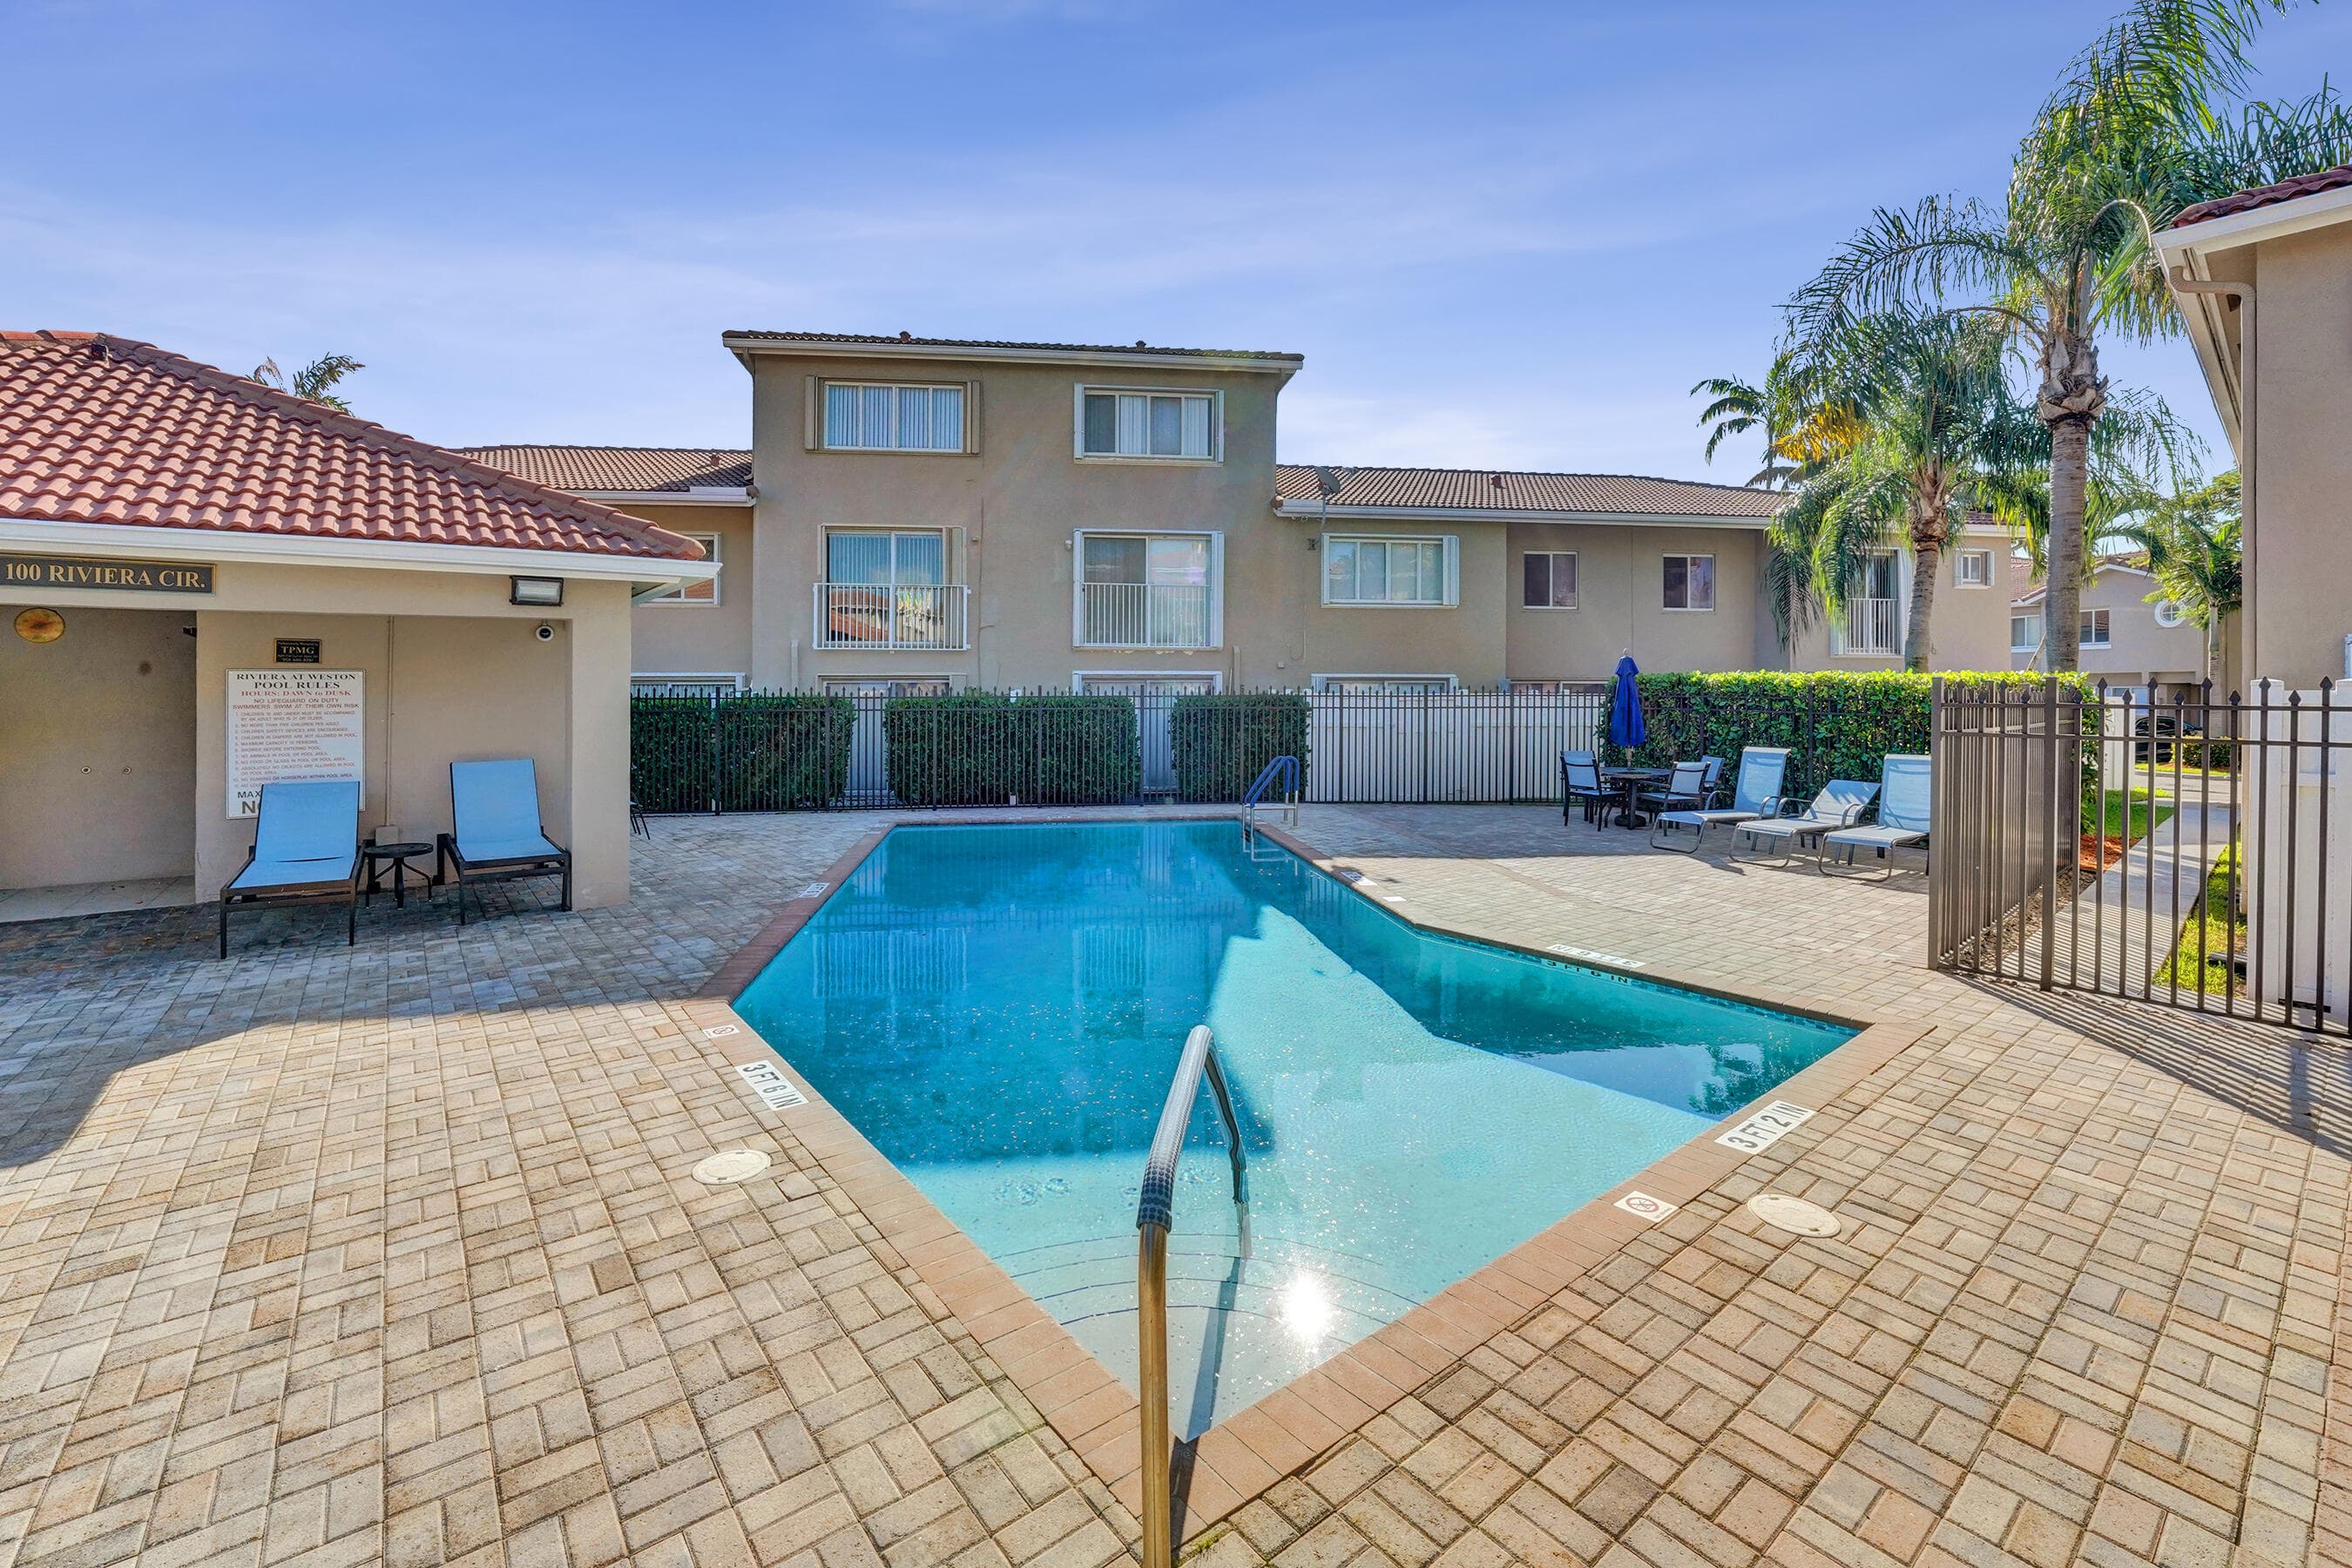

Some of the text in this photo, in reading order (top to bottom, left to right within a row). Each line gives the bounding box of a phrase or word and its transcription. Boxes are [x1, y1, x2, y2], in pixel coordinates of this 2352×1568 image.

[6, 563, 206, 588] 100 RIVIERA CIR.
[242, 801, 260, 814] N
[1611, 975, 1628, 983] IN
[743, 1064, 802, 1108] 3 FT 6 IN
[1728, 1103, 1809, 1148] 3 FT 2 IN
